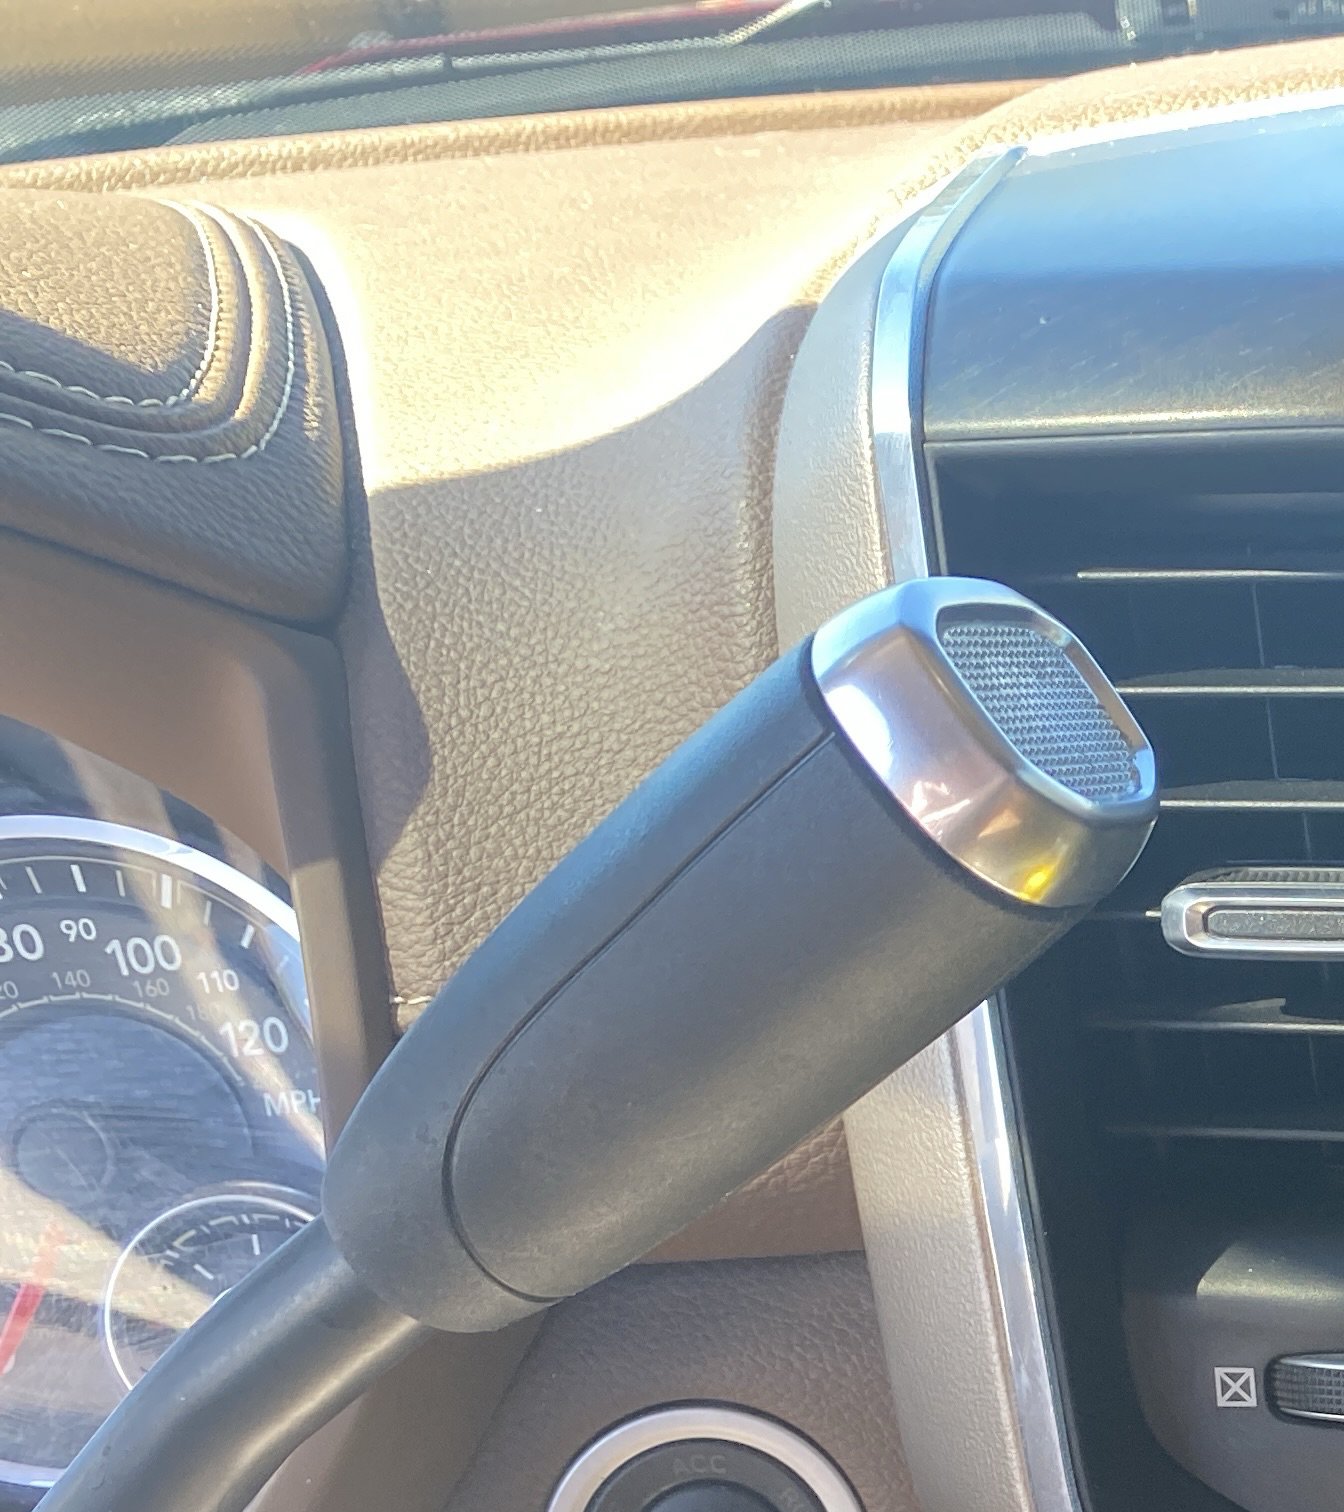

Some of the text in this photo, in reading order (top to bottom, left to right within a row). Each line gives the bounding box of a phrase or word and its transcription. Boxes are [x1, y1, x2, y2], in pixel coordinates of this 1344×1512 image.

[59, 918, 97, 944] 90
[104, 934, 183, 977] 100
[51, 969, 91, 990] 140
[132, 977, 170, 998] 160
[196, 969, 240, 994] 110
[218, 1015, 290, 1058] 120
